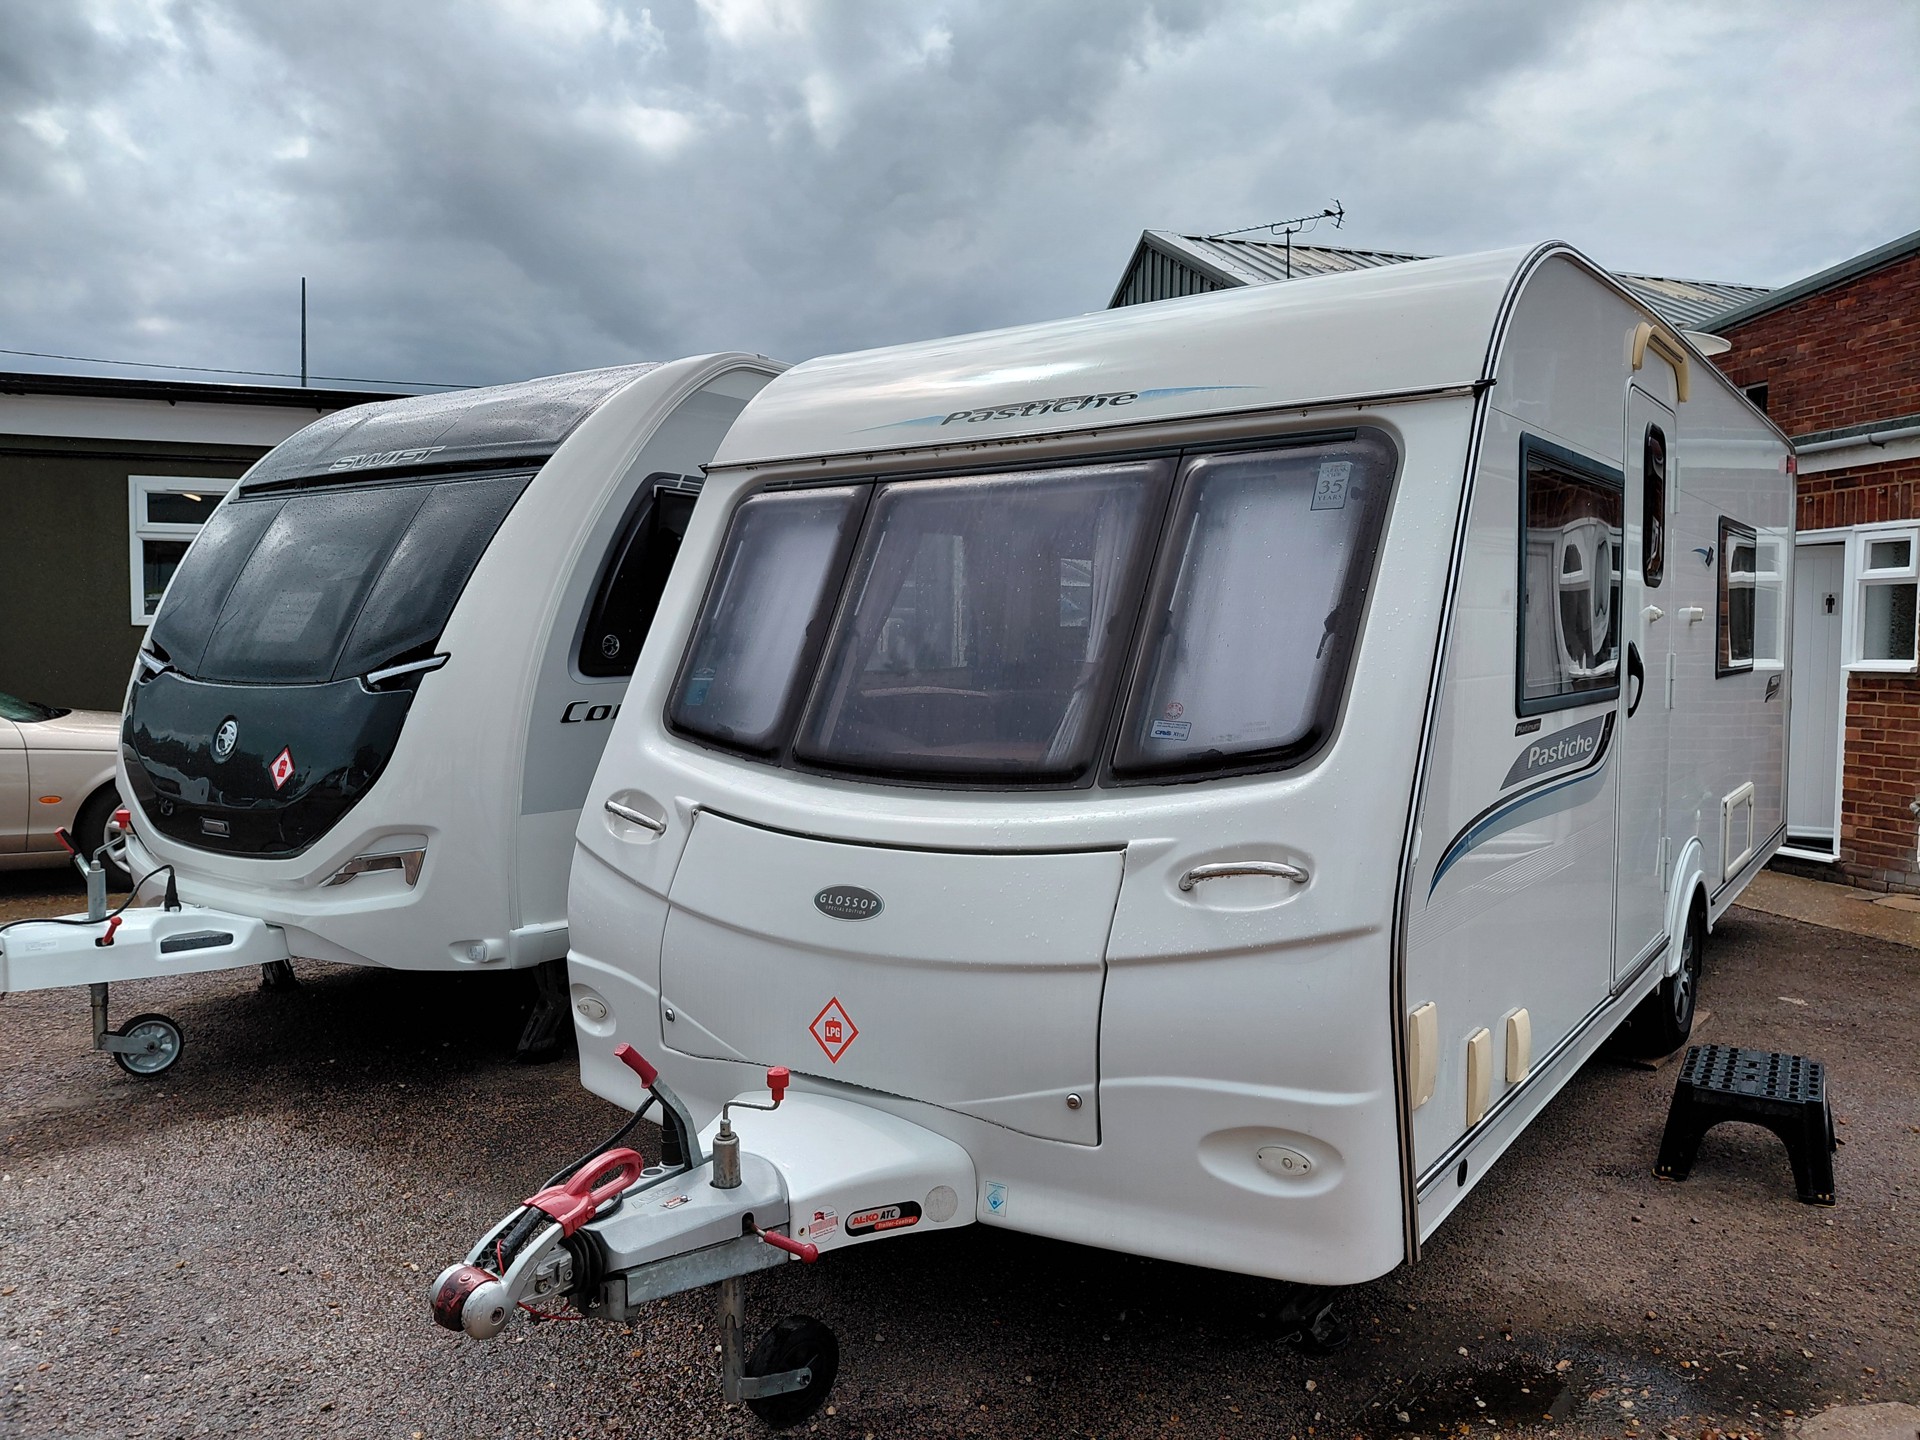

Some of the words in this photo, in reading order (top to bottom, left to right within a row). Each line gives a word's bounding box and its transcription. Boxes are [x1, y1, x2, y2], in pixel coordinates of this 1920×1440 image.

[328, 445, 447, 471] SWIFT
[1318, 478, 1345, 495] 35
[1516, 721, 1541, 734] Platinum
[1527, 734, 1593, 769] Pastiche
[819, 893, 878, 910] GLOSSOP
[826, 1026, 841, 1038] LPG
[852, 1212, 879, 1226] AL-KO
[880, 1208, 897, 1220] ATC
[878, 1217, 914, 1230] Trailer-Control
